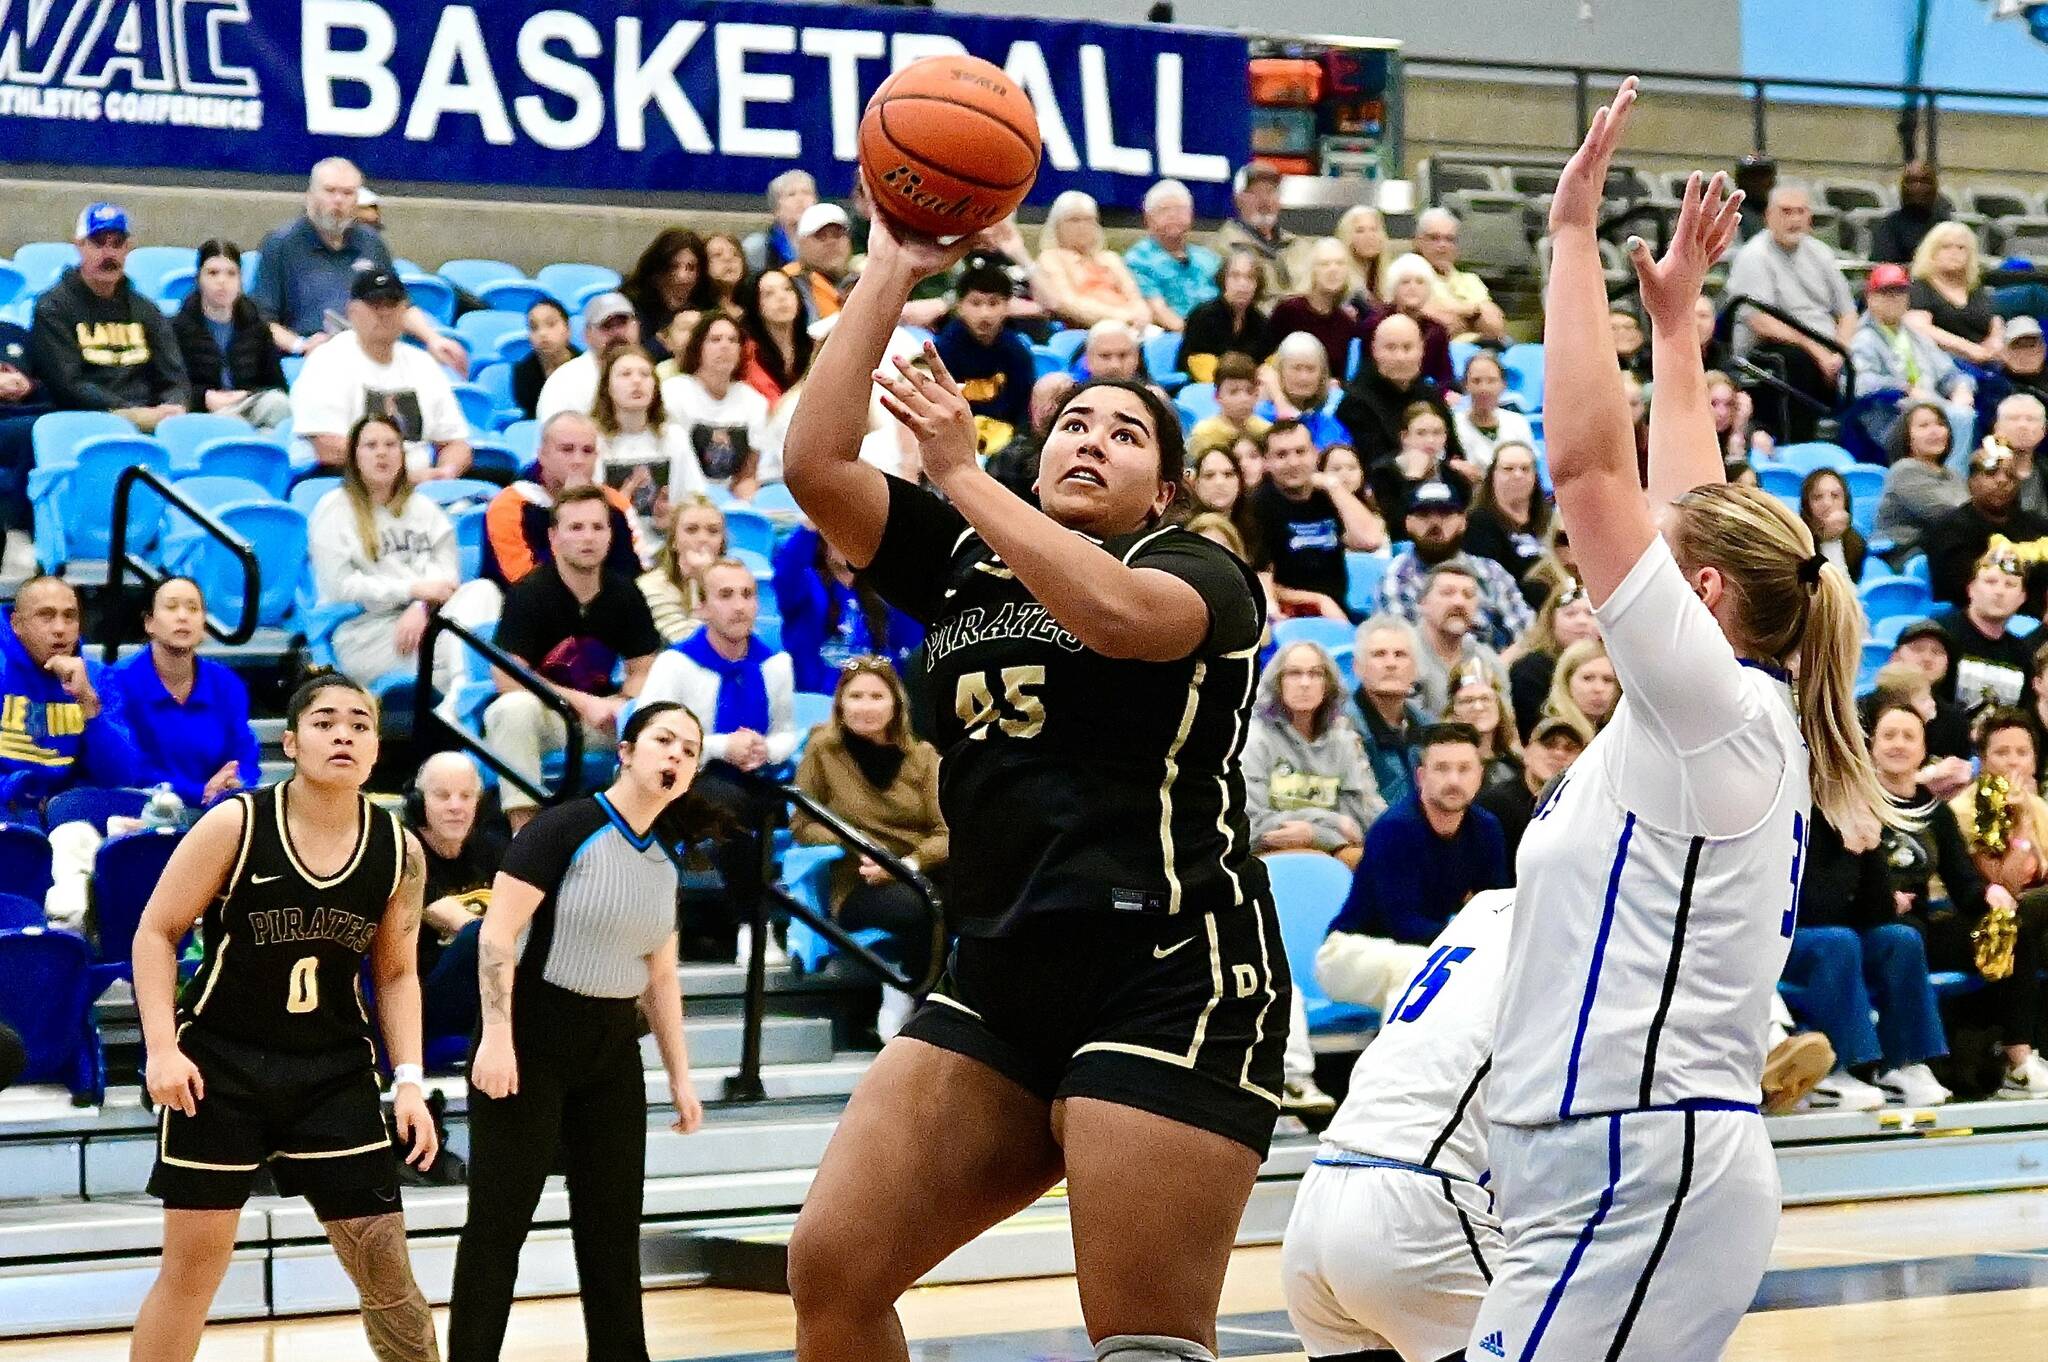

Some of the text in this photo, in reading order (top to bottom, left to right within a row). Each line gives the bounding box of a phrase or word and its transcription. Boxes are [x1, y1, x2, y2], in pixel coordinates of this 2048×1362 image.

[105, 91, 264, 130] CONFERENCE
[301, 0, 1231, 183] BASKETALL
[955, 665, 1047, 740] 45
[248, 907, 377, 953] PIRATES
[286, 955, 319, 1014] 0
[1386, 945, 1476, 1025] 15
